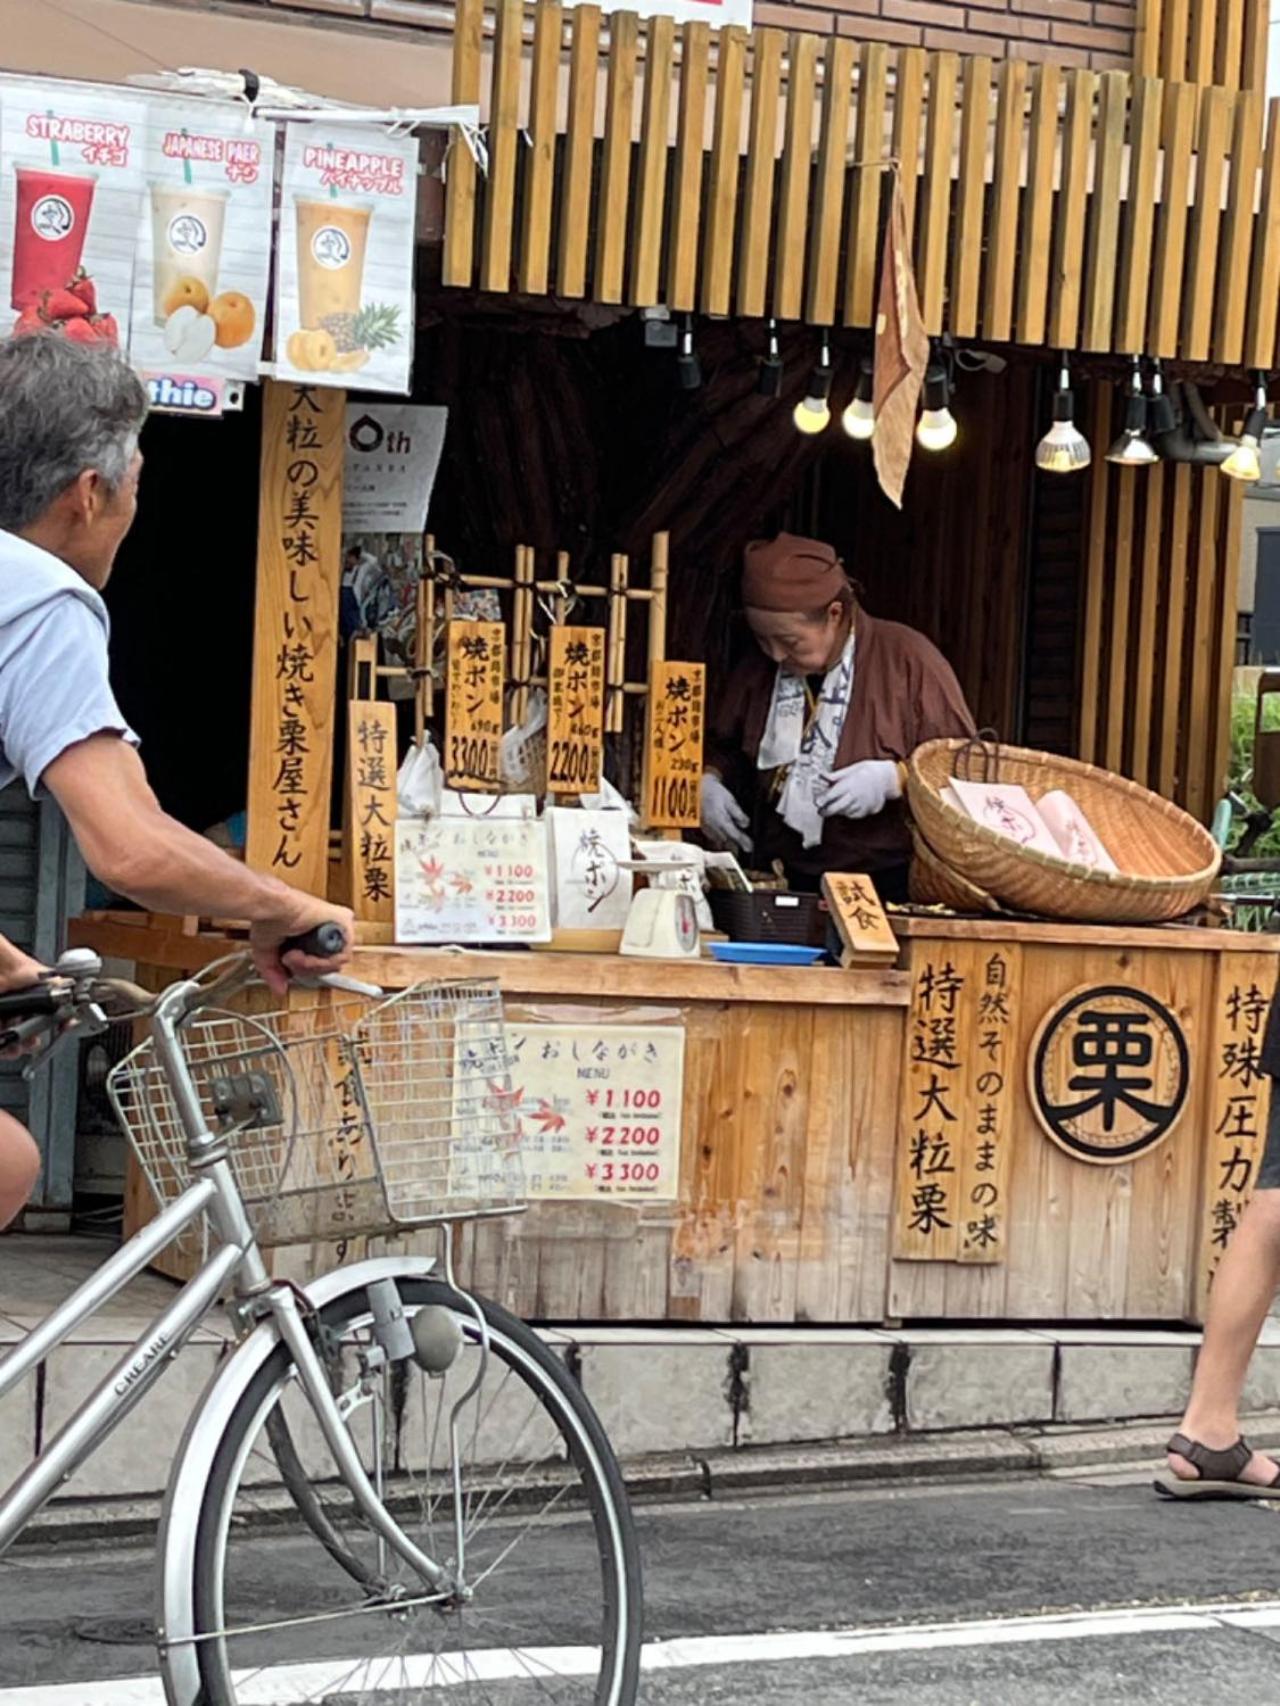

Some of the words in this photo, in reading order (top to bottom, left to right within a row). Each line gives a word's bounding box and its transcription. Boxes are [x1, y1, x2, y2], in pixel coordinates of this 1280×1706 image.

[26, 115, 129, 146] STRABERRY
[304, 146, 403, 178] PINEAPPLE
[664, 674, 692, 753] 焼ポン
[549, 740, 590, 785] 2200
[358, 719, 393, 902] 特選大粒栗
[651, 775, 689, 819] 1100
[836, 881, 880, 930] 試食
[577, 1067, 610, 1079] MENU
[908, 961, 965, 1236] 特選大粒栗
[963, 952, 1009, 1250] 自然そのままの味
[1050, 1009, 1174, 1133] 栗
[1208, 982, 1268, 1292] 特殊圧力製
